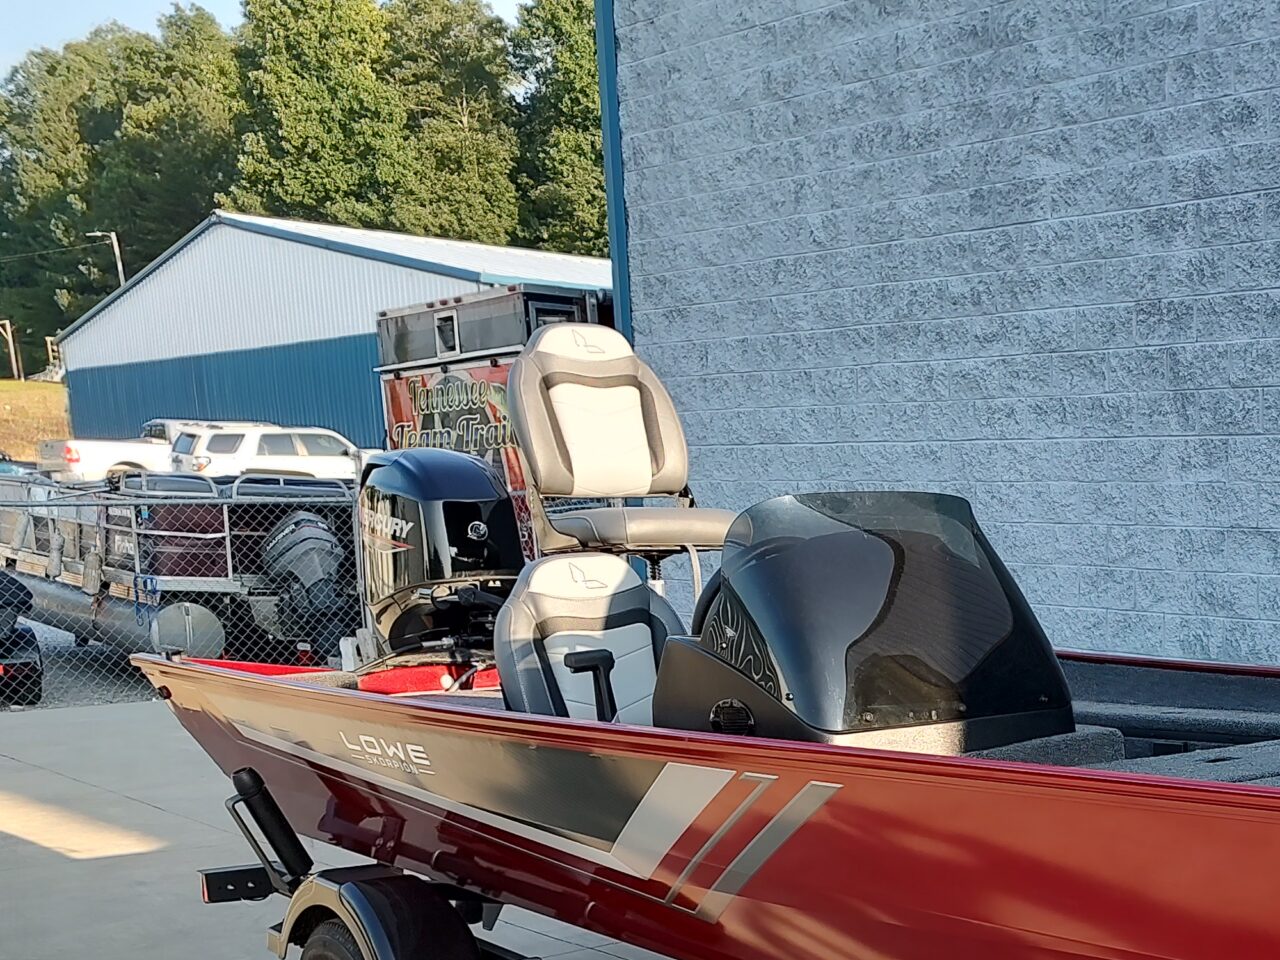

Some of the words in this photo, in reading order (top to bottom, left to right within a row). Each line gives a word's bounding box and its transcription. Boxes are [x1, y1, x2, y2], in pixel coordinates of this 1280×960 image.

[408, 377, 488, 415] Tennessee
[393, 421, 455, 449] Team
[339, 731, 431, 766] LOWE
[365, 755, 419, 775] SKORPION
